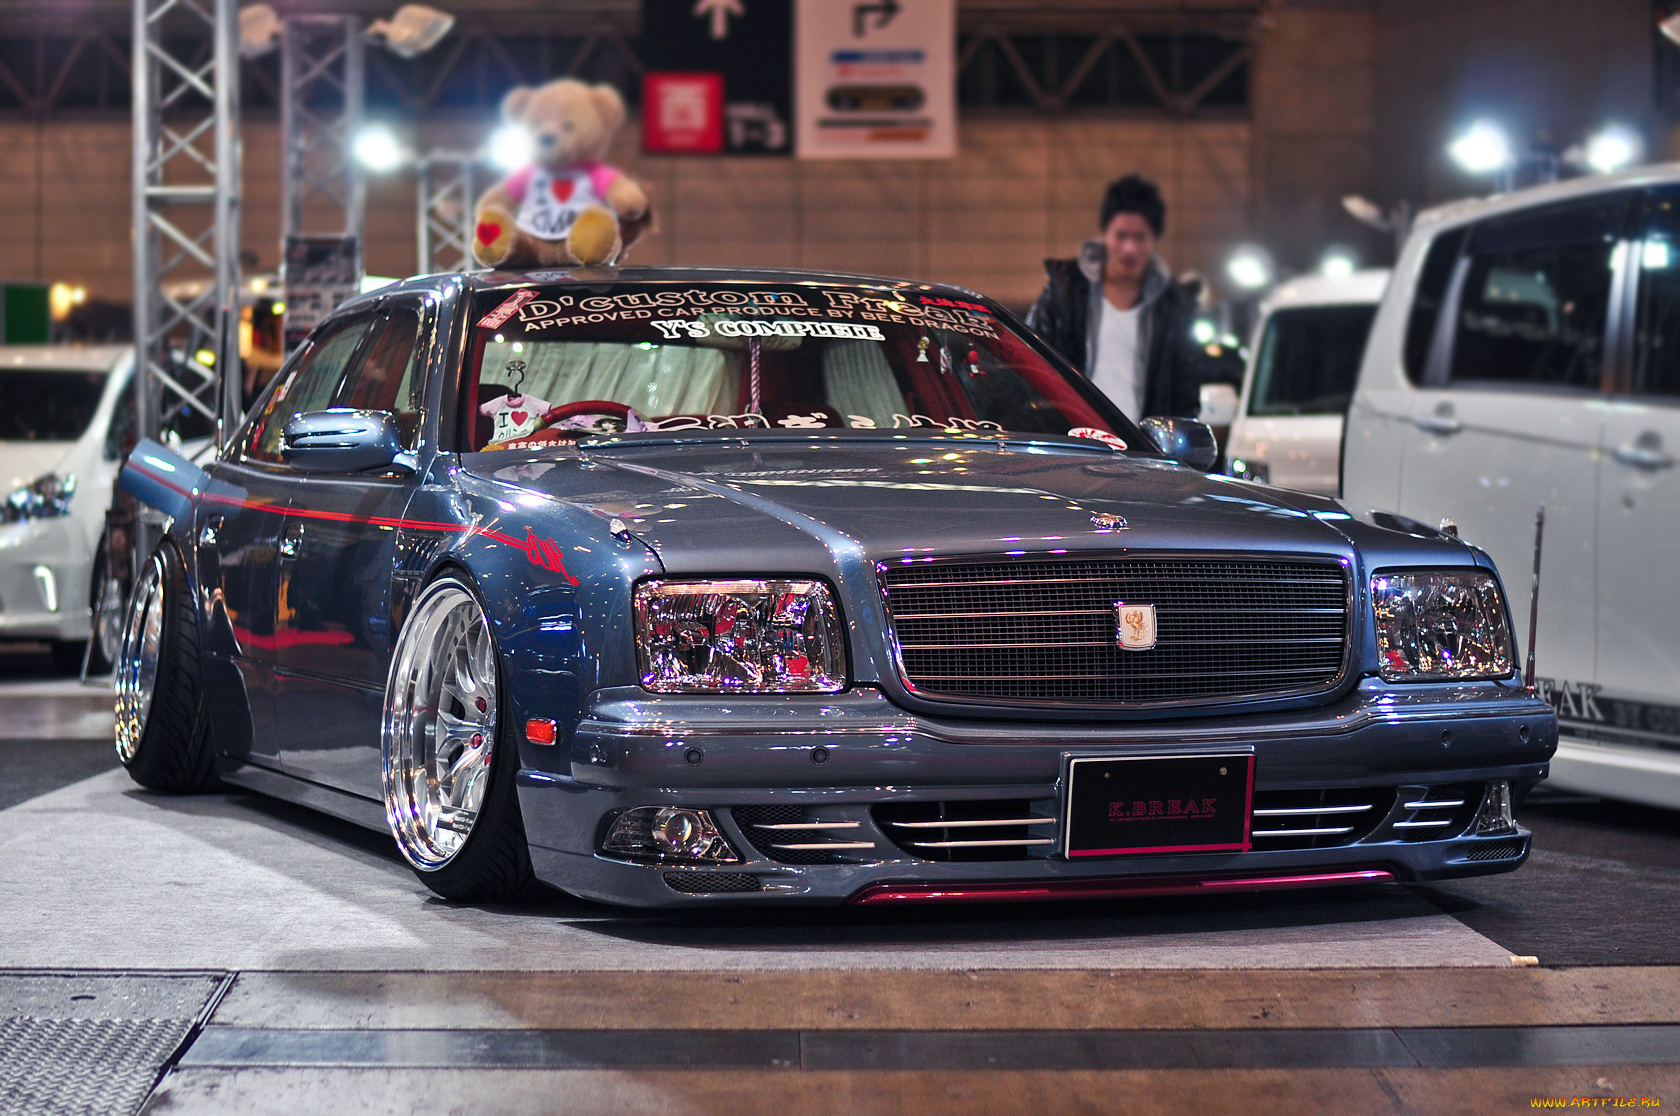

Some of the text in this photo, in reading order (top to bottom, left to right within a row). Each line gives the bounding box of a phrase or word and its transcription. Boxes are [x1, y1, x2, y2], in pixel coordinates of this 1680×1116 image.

[518, 289, 808, 322] D'custom
[524, 306, 1000, 340] APPROVED CAR PRODUCE BY BEE DRAGON
[714, 320, 886, 341] COMPLETE
[498, 412, 509, 429] I
[1534, 677, 1605, 721] EAK
[1108, 798, 1217, 817] K.BREAK
